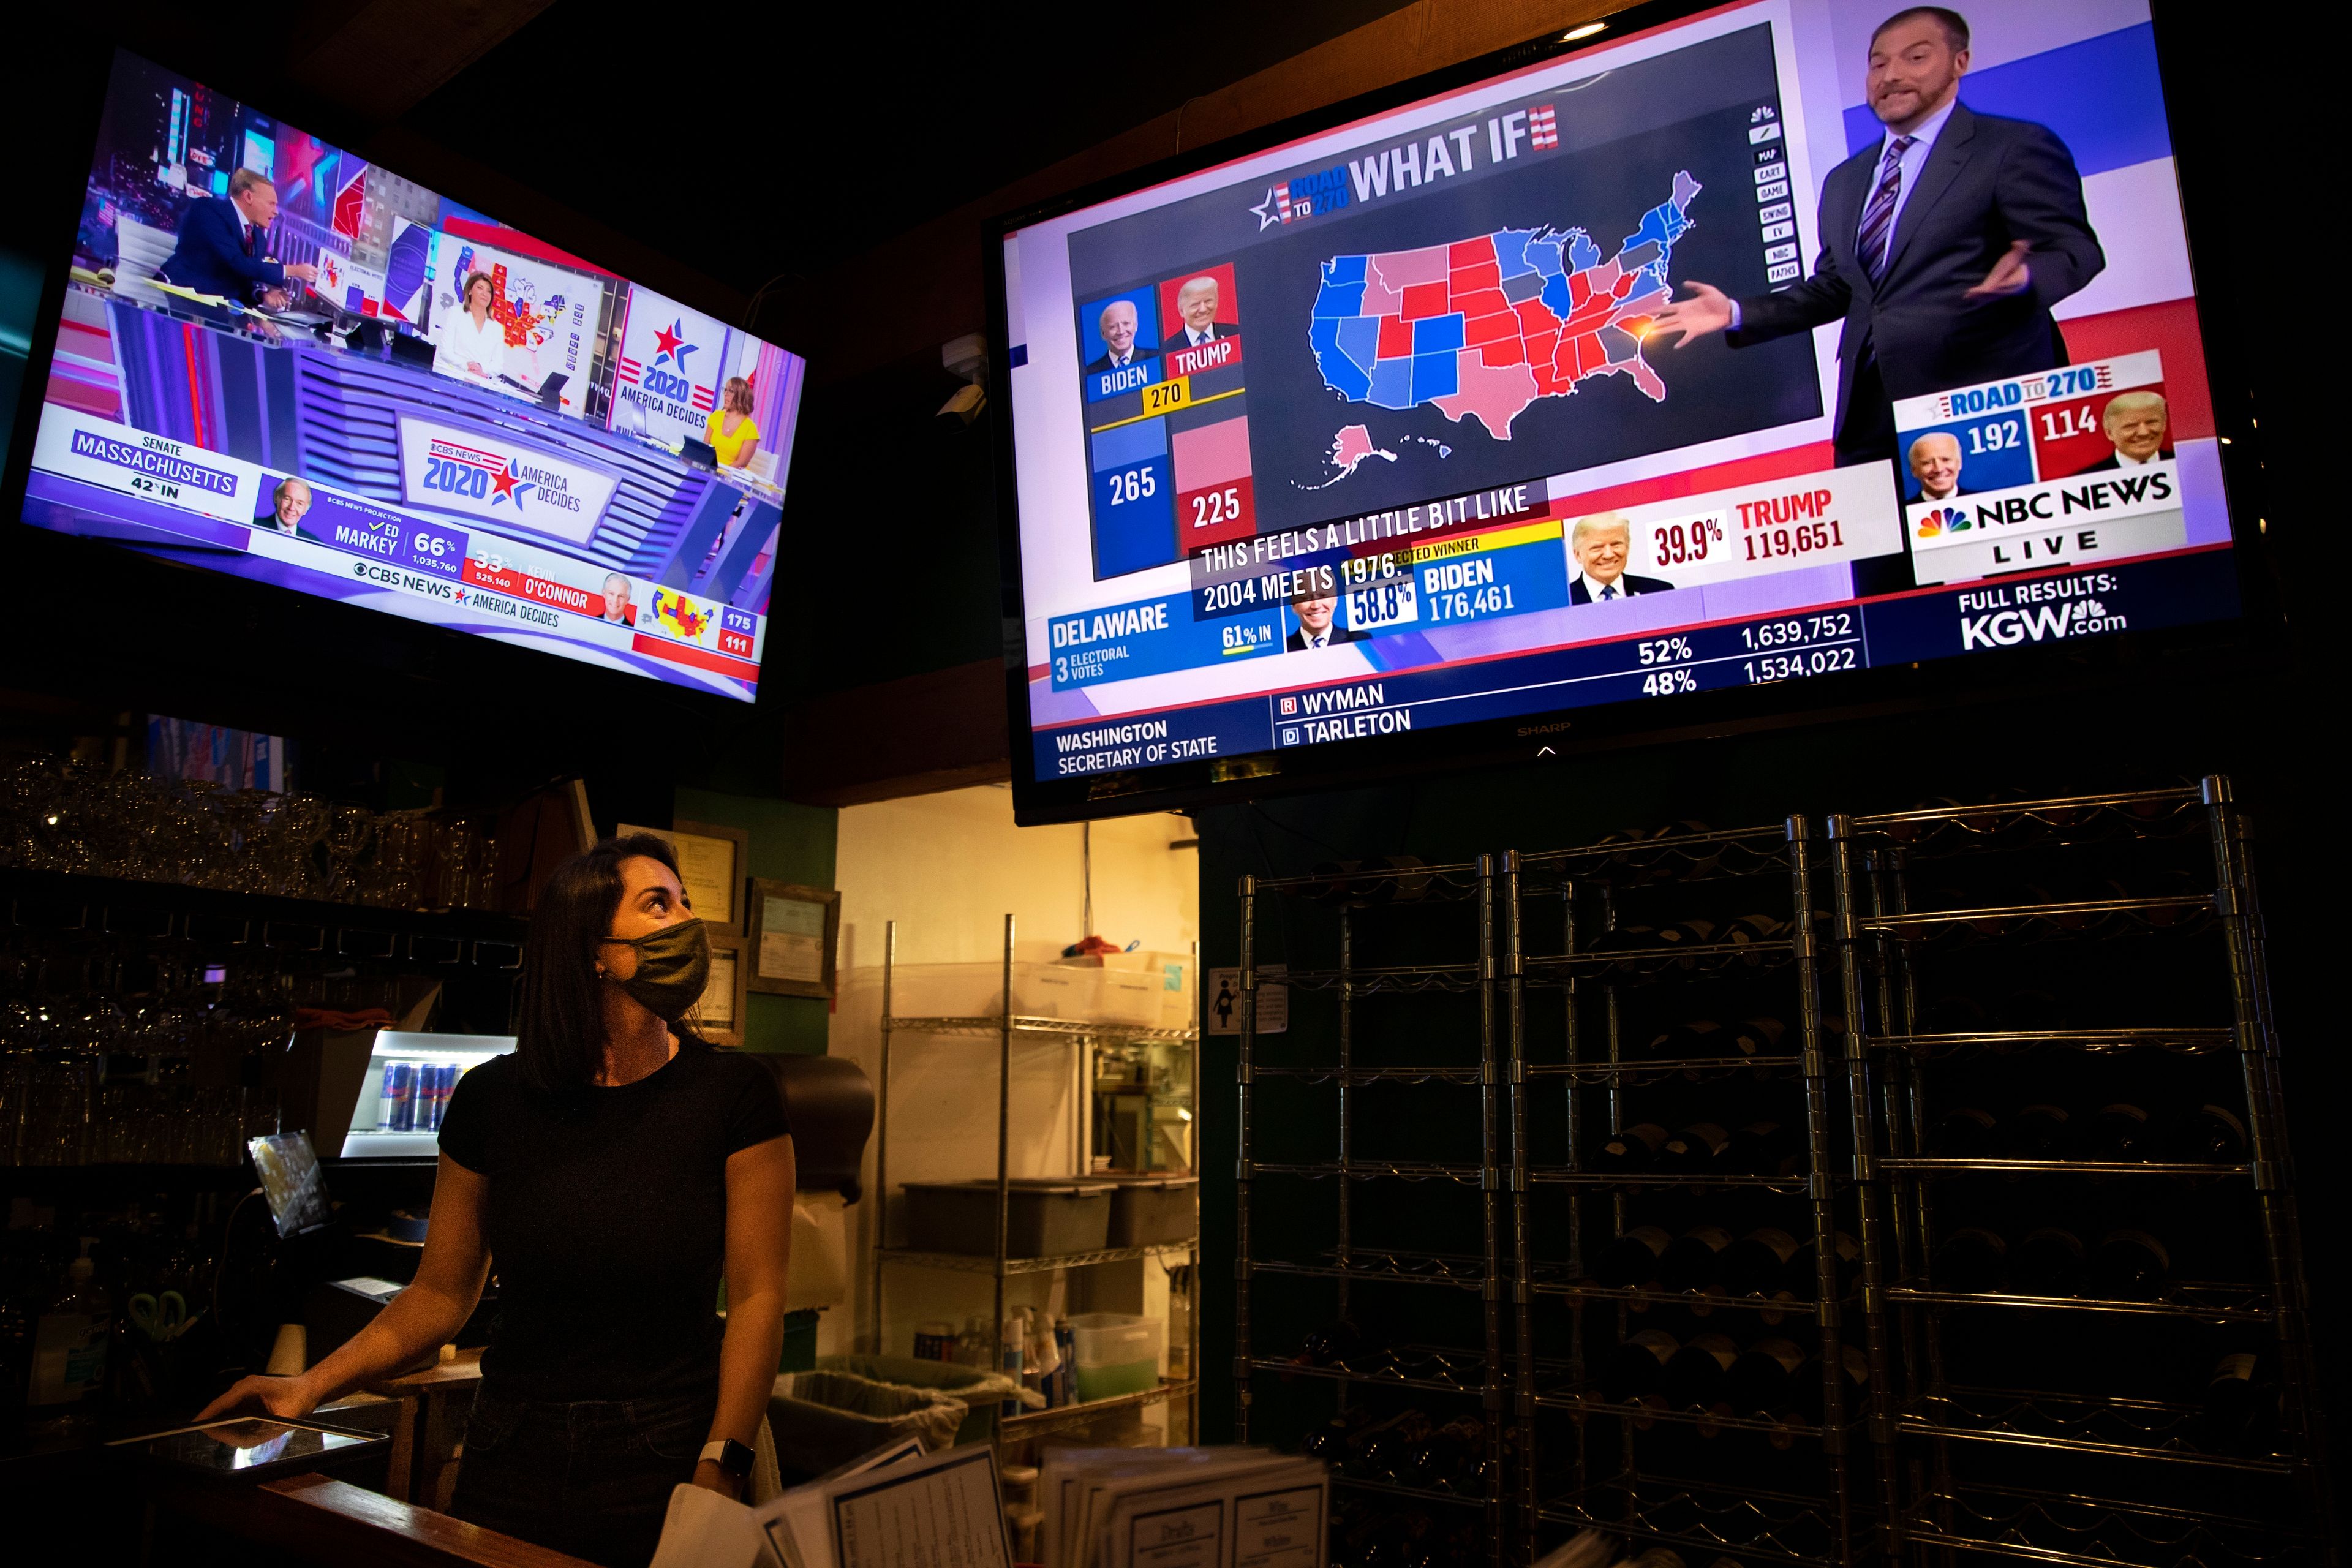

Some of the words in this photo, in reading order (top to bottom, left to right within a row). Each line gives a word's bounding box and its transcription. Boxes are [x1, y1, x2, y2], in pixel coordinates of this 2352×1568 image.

[1349, 125, 1477, 202] WHAT
[1488, 111, 1526, 164] IF
[1290, 167, 1346, 199] ROAD
[1293, 200, 1312, 218] TO
[1312, 190, 1349, 216] 270
[1175, 342, 1232, 375] TRUMP
[643, 366, 690, 403] 2020
[1101, 364, 1148, 396] BIDEN
[1151, 383, 1181, 409] 270
[1950, 382, 2021, 417] ROAD
[2024, 380, 2046, 399] TO
[2047, 368, 2096, 399] 270
[621, 386, 663, 413] AMERICA
[666, 405, 706, 429] DECIDES
[2040, 405, 2097, 442] 114
[142, 435, 183, 457] SENATE
[435, 445, 453, 457] CBS
[455, 450, 481, 462] NEWS
[1967, 420, 2021, 455] 192
[76, 434, 233, 494] MASSACHUSETTS
[424, 457, 488, 499] 2020
[521, 465, 567, 492] AMERICA
[161, 483, 179, 499] IN
[537, 487, 581, 513] DECIDES
[1109, 467, 1156, 506] 265
[1977, 492, 2054, 530] NBC
[2062, 472, 2171, 513] NEWS
[364, 507, 402, 523] PROJECTION
[1192, 488, 1240, 528] 225
[1736, 489, 1832, 529] TRUMP
[335, 525, 398, 556] MARKEY
[384, 523, 399, 538] ED
[413, 532, 456, 558] 66%
[1200, 542, 1250, 574] THIS
[1254, 527, 1320, 563] FEELS
[1325, 524, 1340, 549] A
[1344, 508, 1424, 546] LITTLE
[1429, 499, 1468, 529] BIT
[1477, 486, 1530, 521] LIKE
[1433, 537, 1480, 557] WINNER
[1654, 517, 1723, 567] 39.9%
[1744, 519, 1844, 562] 119,651
[1994, 530, 2098, 564] LIVE
[412, 554, 458, 574] 1,035,760
[473, 549, 513, 573] 33%
[527, 564, 556, 583] KEVIN
[1423, 557, 1494, 594] BIDEN
[475, 571, 511, 589] 525,140
[524, 577, 588, 609] O'CONNOR
[1204, 584, 1257, 612] 2004
[1261, 565, 1334, 601] MEETS
[1340, 552, 1402, 587] 1976.
[1958, 589, 2011, 614] FULL
[2015, 573, 2118, 605] RESULTS:
[368, 567, 401, 585] CBS
[402, 578, 451, 600] NEWS
[472, 593, 517, 616] AMERICA
[520, 605, 559, 628] DECIDES
[1354, 581, 1412, 626] 58.8%
[1429, 584, 1515, 622] 176,461
[726, 612, 752, 631] 175
[1052, 603, 1169, 649] DELAWARE
[1222, 624, 1257, 649] 61%
[1259, 625, 1273, 643] IN
[1961, 602, 2127, 650] KGW.com
[725, 635, 747, 652] 111
[1638, 637, 1693, 665] 52%
[1741, 613, 1852, 650] 1,639,752
[1055, 657, 1069, 683] 3
[1070, 646, 1130, 667] ELECTORAL
[1071, 663, 1104, 680] VOTES
[1643, 668, 1697, 696] 48%
[1744, 647, 1856, 684] 1,534,022
[1302, 684, 1385, 715] WYMAN
[1056, 720, 1167, 753] WASHINGTON
[1303, 710, 1412, 744] TARLETON
[1516, 722, 1572, 737] SHARP
[1058, 743, 1140, 775] SECRETARY
[1146, 742, 1167, 762] OF
[1170, 735, 1218, 759] STATE
